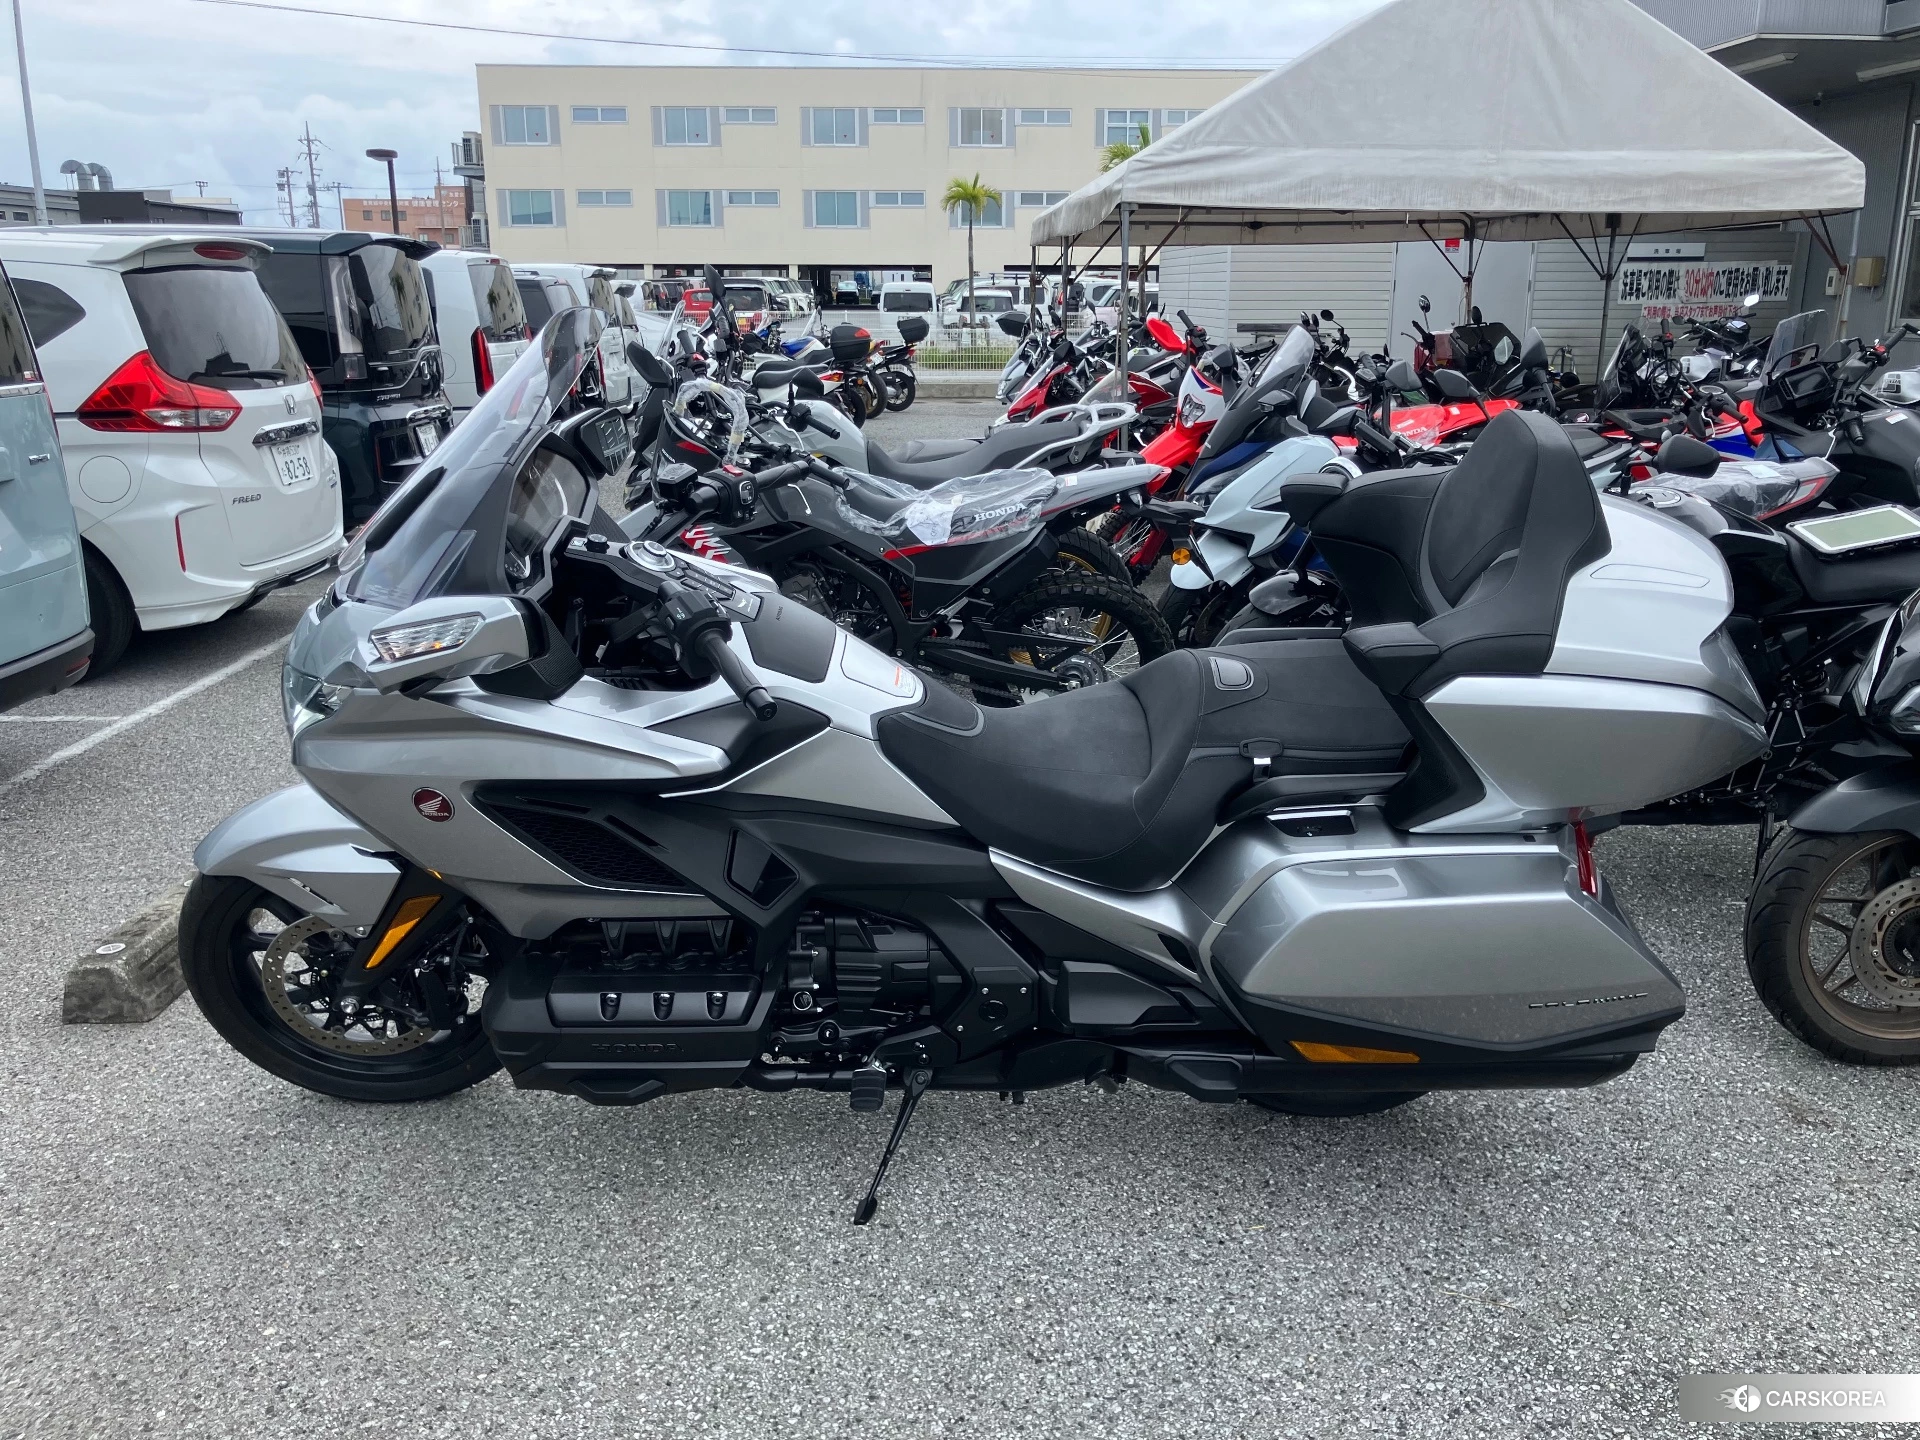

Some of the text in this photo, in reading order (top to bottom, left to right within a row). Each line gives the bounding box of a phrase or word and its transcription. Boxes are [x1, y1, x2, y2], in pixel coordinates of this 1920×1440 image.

[285, 456, 311, 480] 82-58
[232, 493, 262, 506] FREED
[974, 503, 1027, 523] HONDA
[591, 1043, 686, 1053] HONDA
